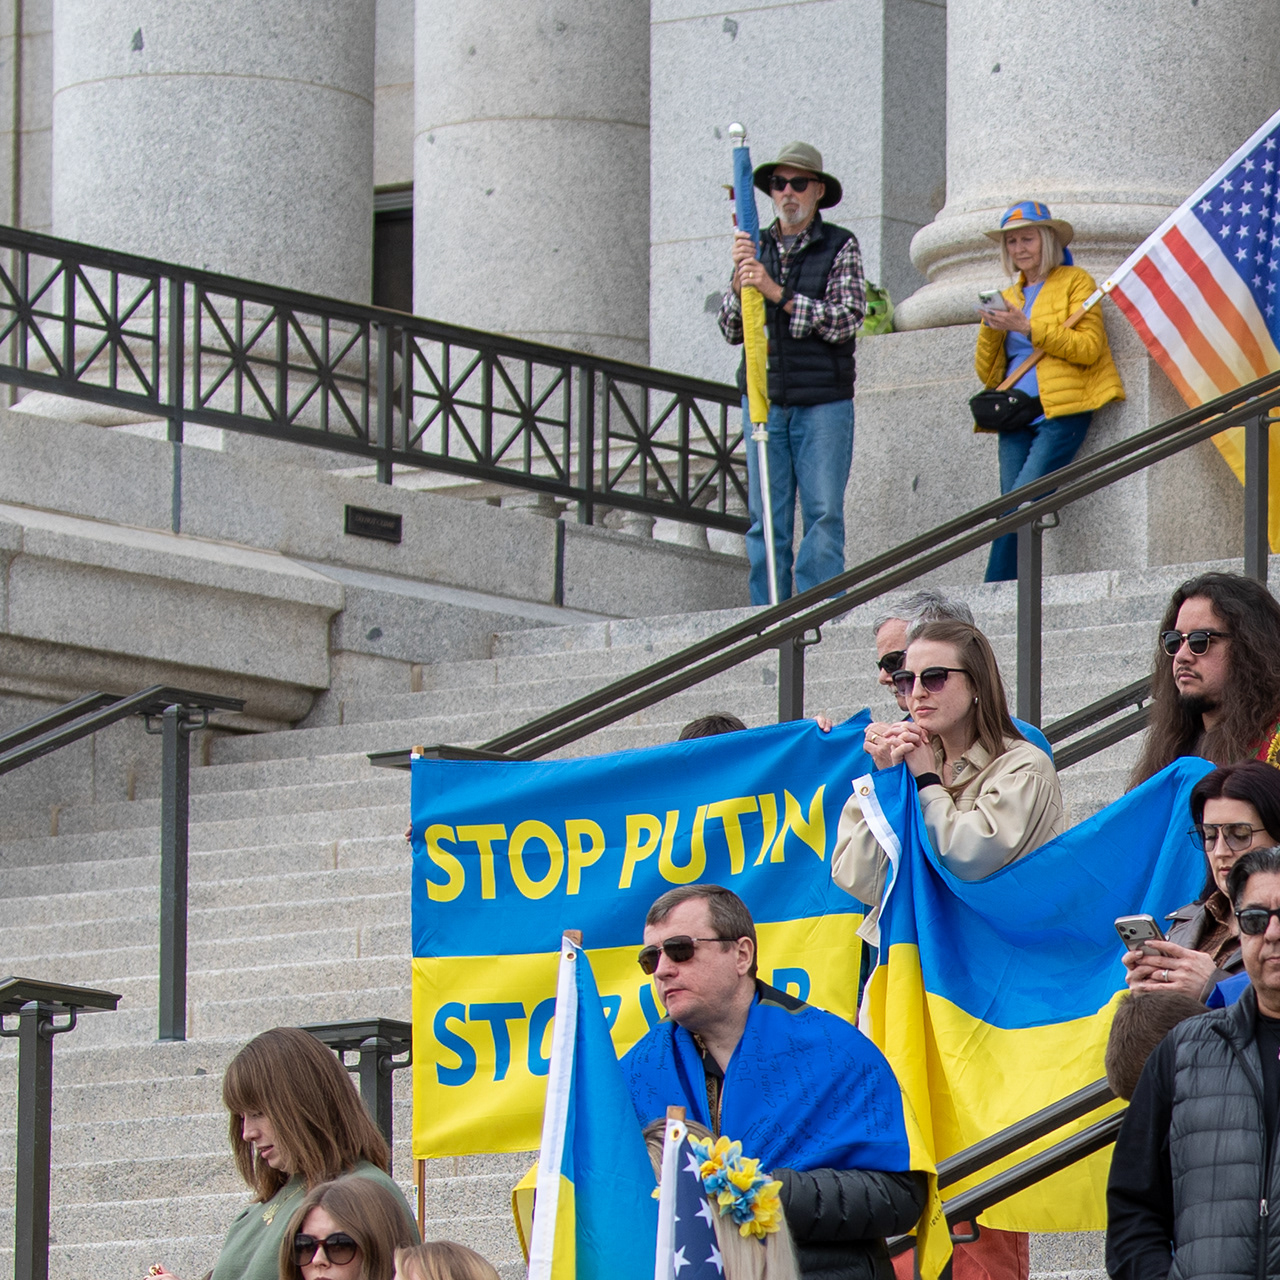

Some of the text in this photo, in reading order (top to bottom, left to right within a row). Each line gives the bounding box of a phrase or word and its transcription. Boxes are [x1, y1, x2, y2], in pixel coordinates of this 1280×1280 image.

[424, 784, 827, 903] STOP PUTIN
[433, 995, 621, 1087] STO
